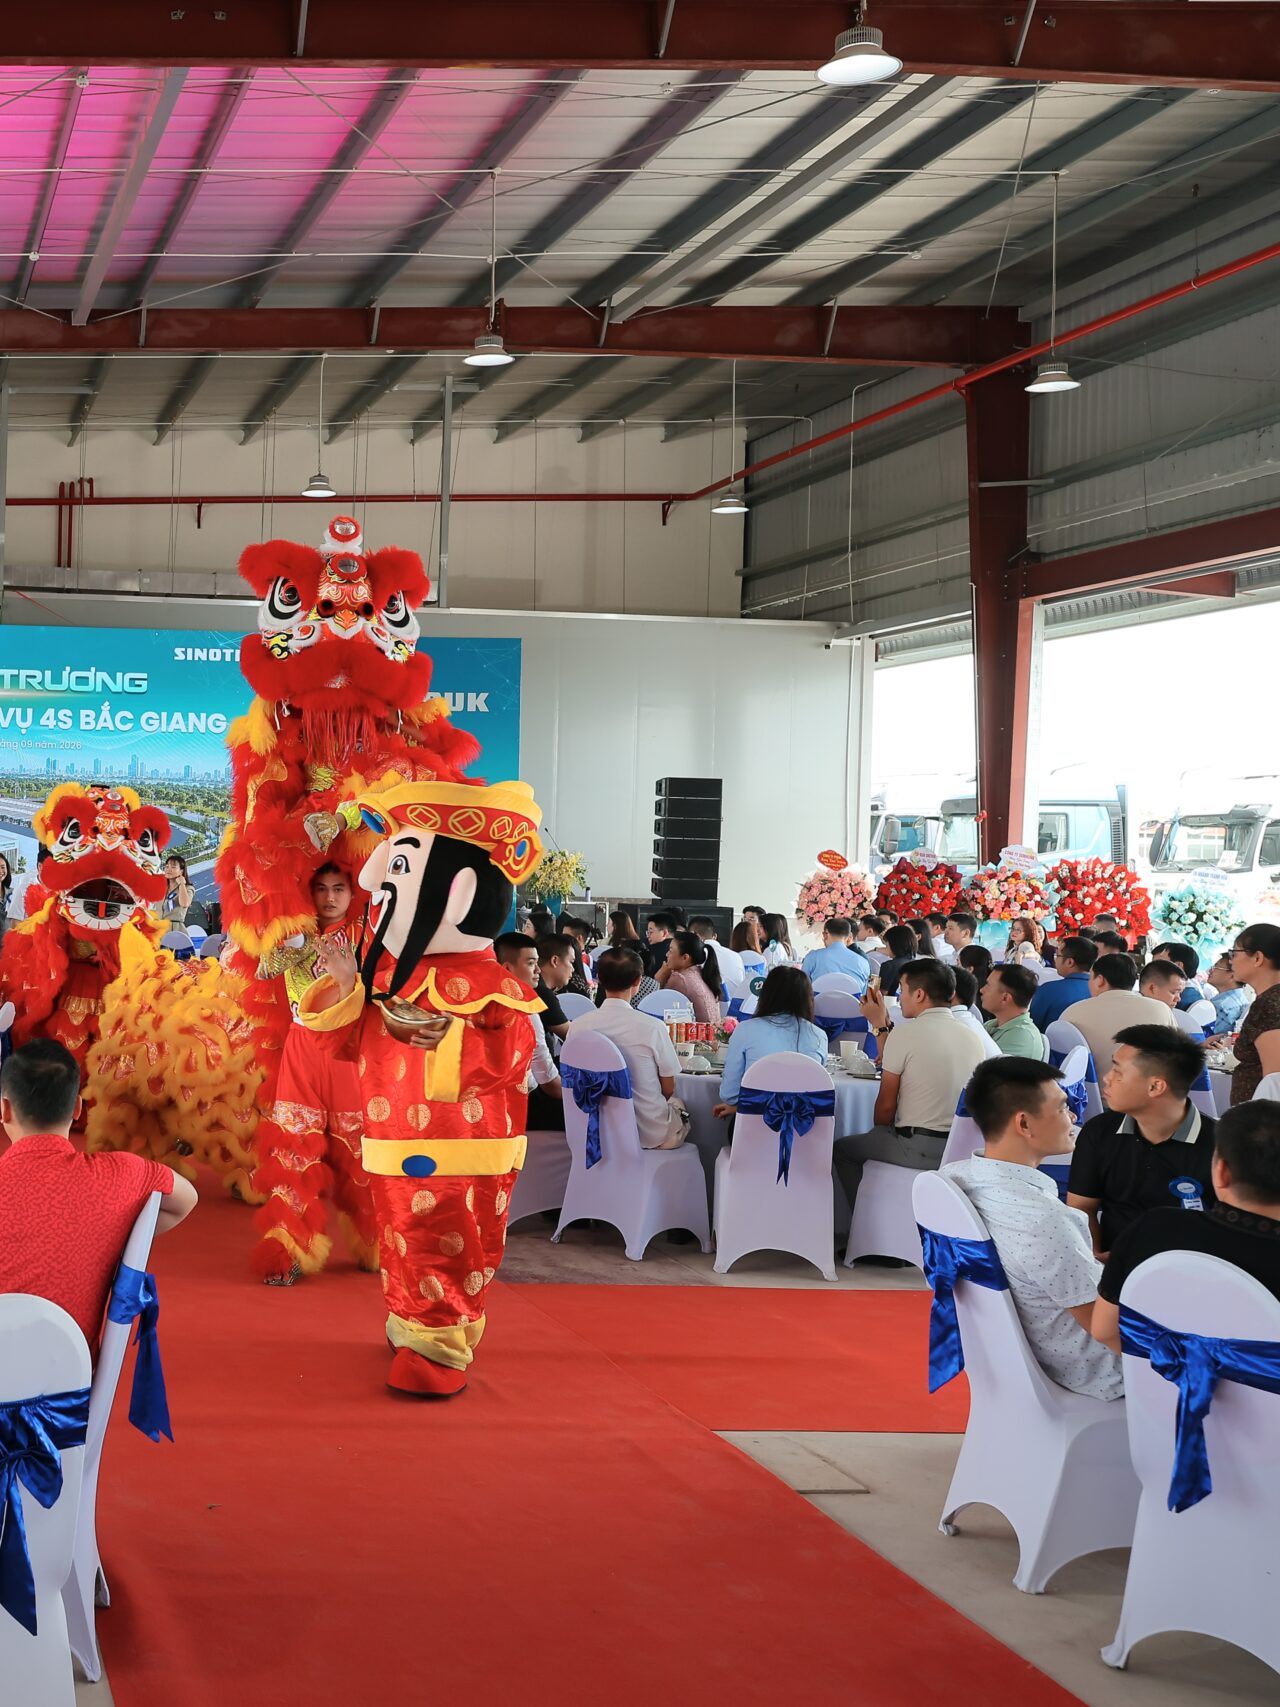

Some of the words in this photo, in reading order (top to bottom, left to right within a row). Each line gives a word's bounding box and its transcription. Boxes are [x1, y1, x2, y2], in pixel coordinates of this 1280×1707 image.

[39, 708, 72, 730] 4S
[80, 700, 134, 731] BẮC
[140, 711, 226, 734] GIANG
[21, 740, 33, 749] 09
[59, 741, 82, 750] 2026
